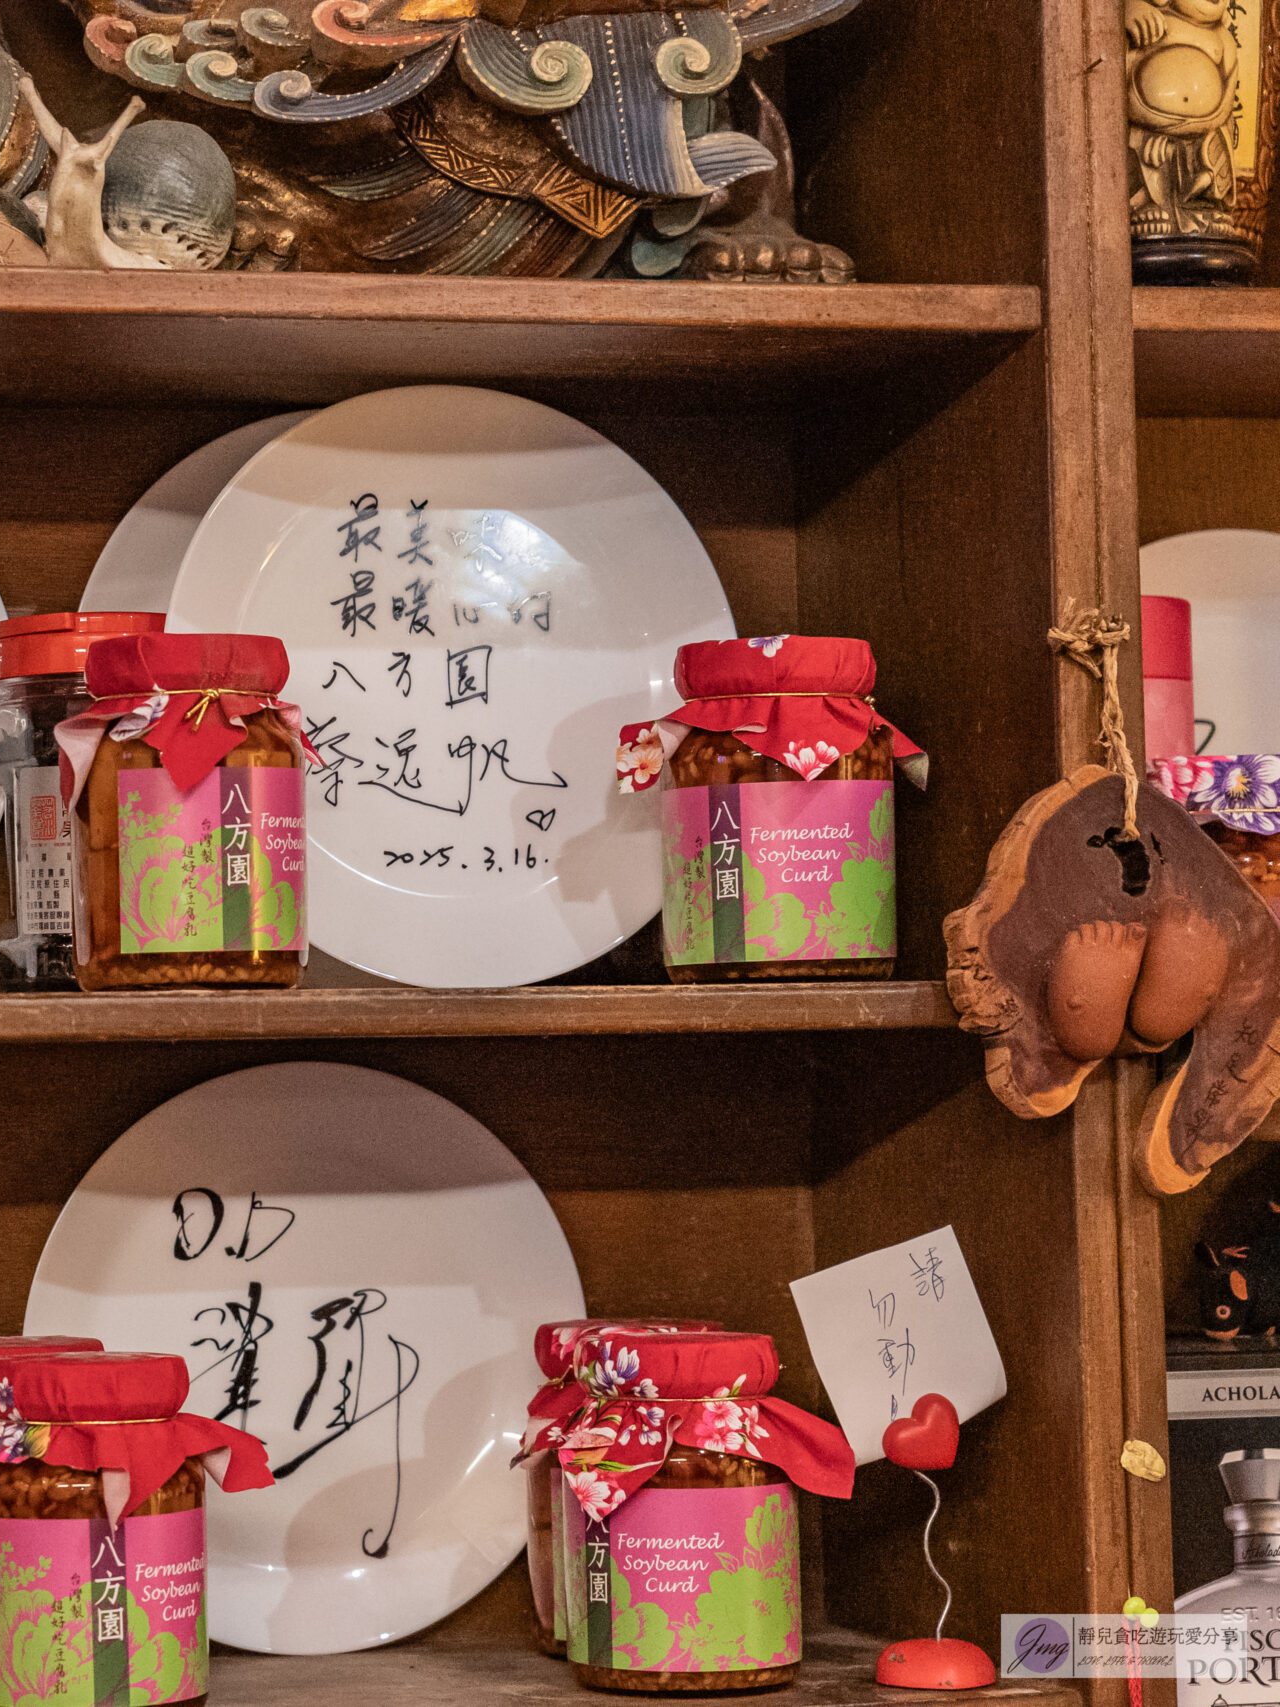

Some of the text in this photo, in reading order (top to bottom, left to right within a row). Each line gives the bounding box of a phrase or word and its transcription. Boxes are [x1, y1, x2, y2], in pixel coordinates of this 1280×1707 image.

[322, 644, 492, 708] 八方園
[221, 783, 252, 887] 八方園
[750, 823, 854, 845] Fermented
[711, 800, 740, 901] 八方園
[757, 844, 841, 867] Soybean
[781, 865, 834, 884] Curd
[1201, 1384, 1280, 1402] ACHOLA
[617, 1532, 725, 1551] Fermented
[135, 1552, 205, 1582] Fermented
[623, 1554, 710, 1575] Soybean
[91, 1535, 126, 1643] 八方園
[141, 1581, 201, 1605] Soybean
[645, 1575, 700, 1593] Curd
[162, 1600, 197, 1622] Curd
